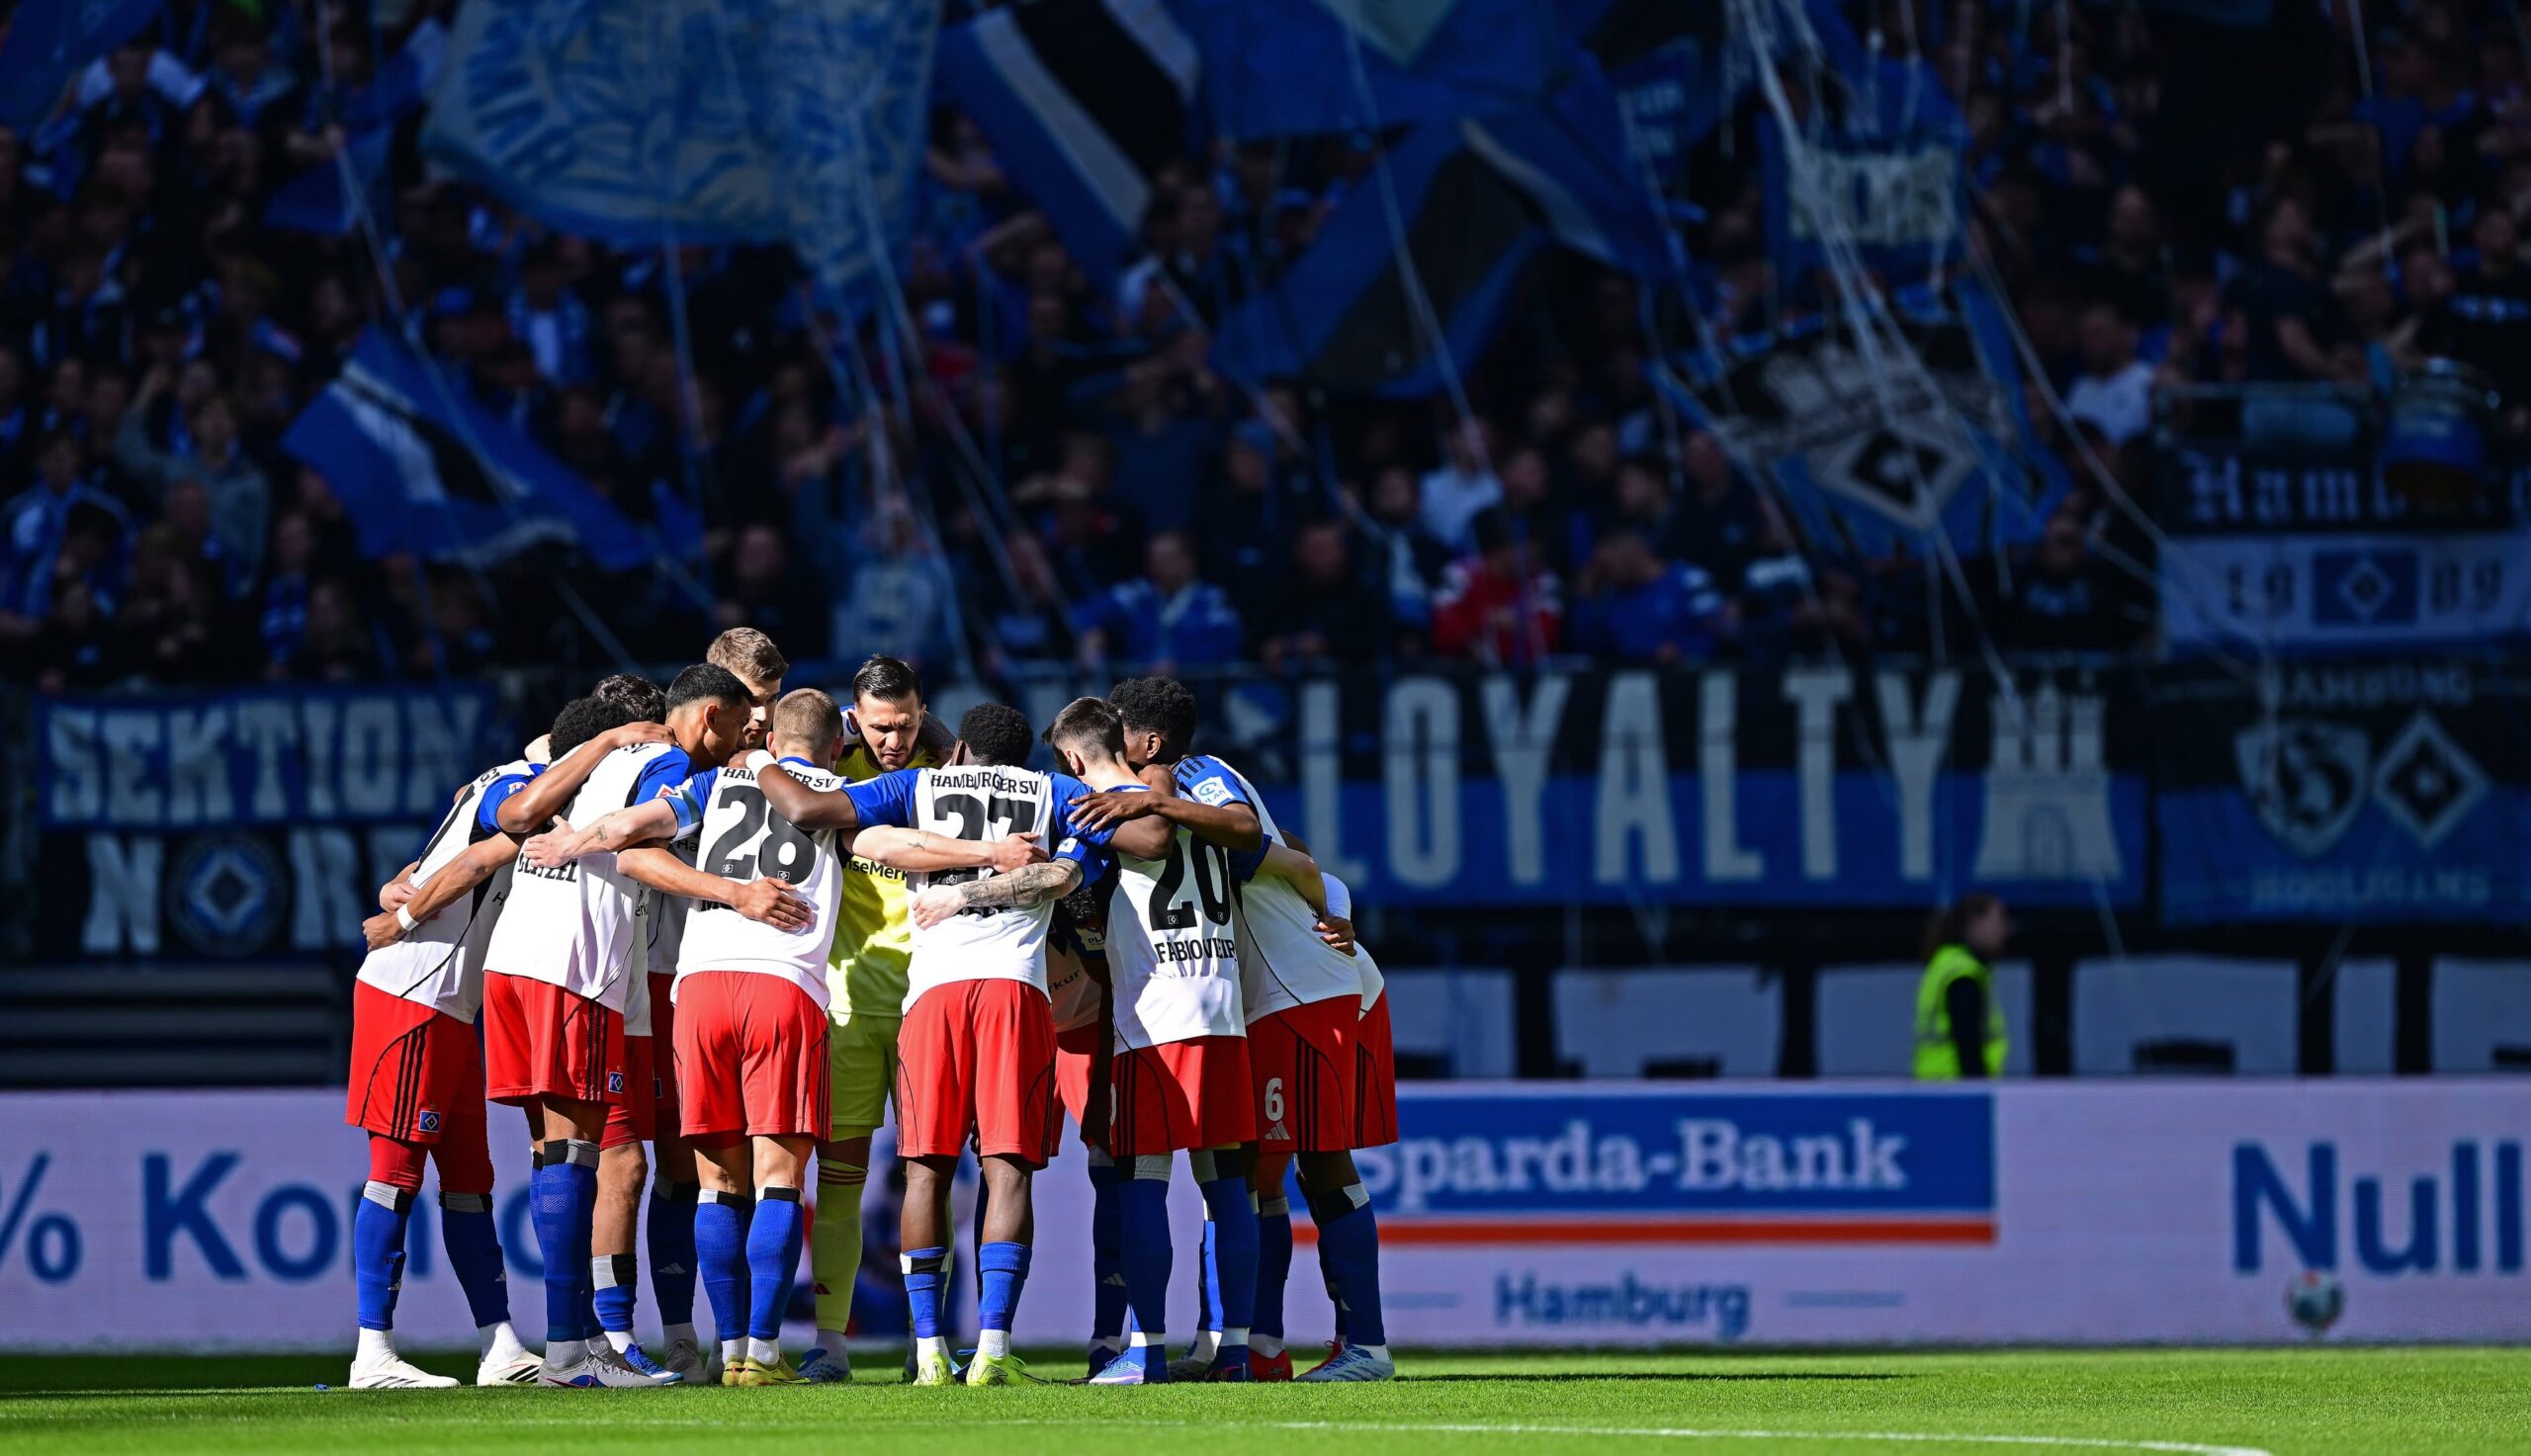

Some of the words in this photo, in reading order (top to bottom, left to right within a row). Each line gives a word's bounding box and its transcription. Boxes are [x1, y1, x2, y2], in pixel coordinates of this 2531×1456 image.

[48, 696, 481, 823] SEKTION
[814, 777, 835, 789] SV
[930, 772, 1017, 793] HAMBURGER
[1019, 781, 1039, 795] SV
[1298, 668, 1964, 890] LOYALTY
[704, 785, 817, 886] 28
[1265, 1077, 1285, 1122] 6
[2232, 1141, 2522, 1276] Null
[1494, 1273, 1751, 1338] Hamburg
